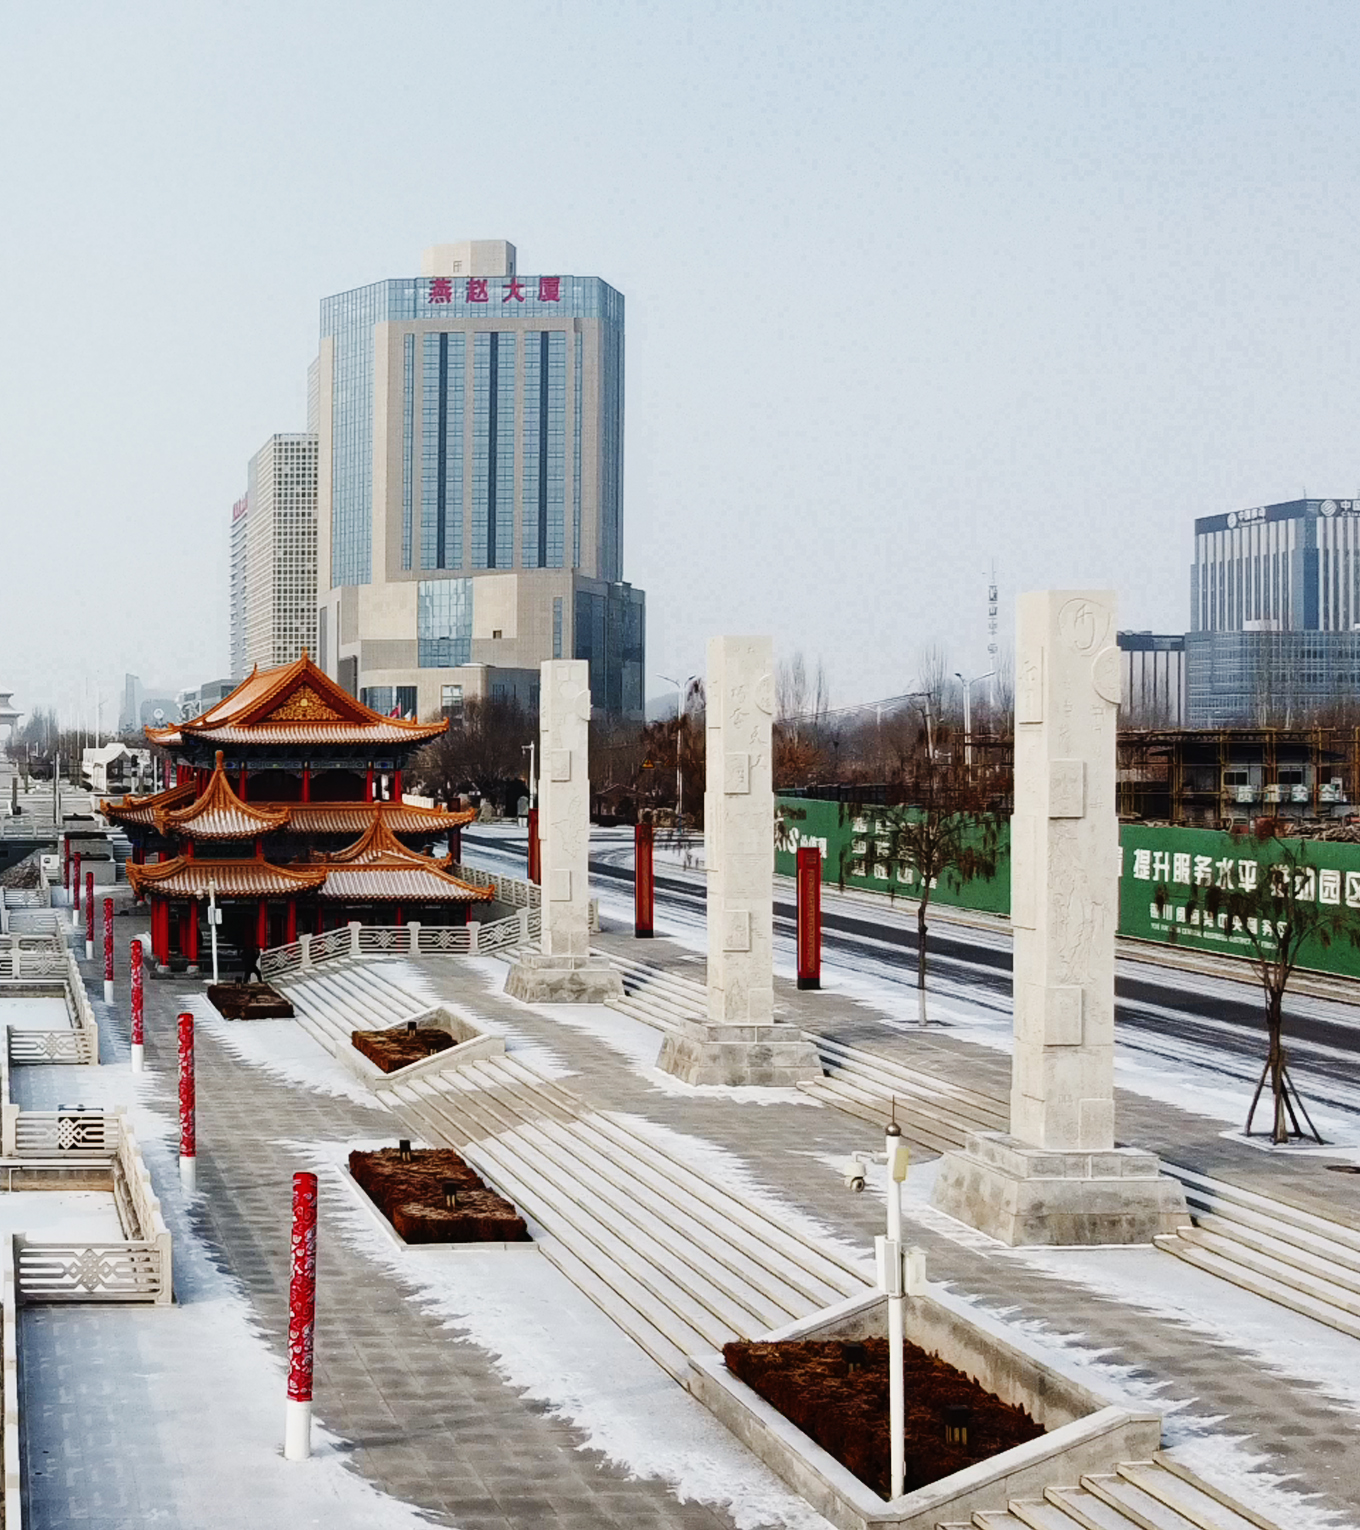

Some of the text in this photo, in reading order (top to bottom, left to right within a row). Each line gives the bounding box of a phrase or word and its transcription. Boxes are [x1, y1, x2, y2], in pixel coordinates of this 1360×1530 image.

[428, 277, 560, 303] 燕赵大厦
[1133, 848, 1258, 893] 提升服务水平
